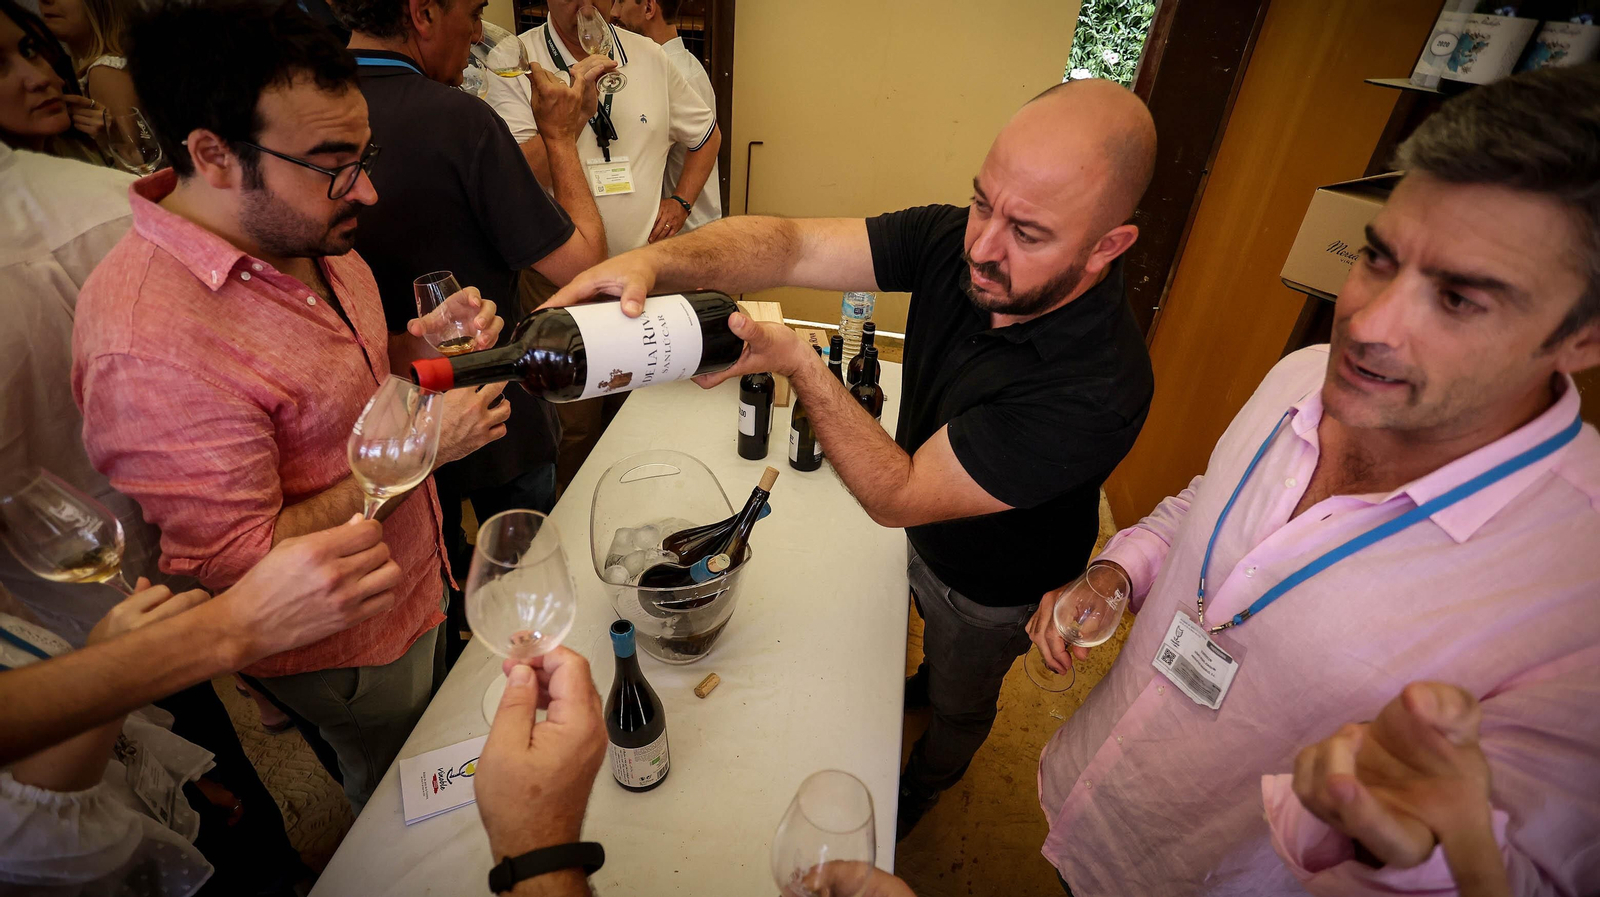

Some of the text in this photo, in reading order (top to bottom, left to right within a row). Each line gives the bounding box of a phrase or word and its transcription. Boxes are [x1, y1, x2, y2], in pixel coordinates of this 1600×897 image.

[1436, 40, 1452, 48] 2020
[641, 310, 658, 383] DE LA RIVA
